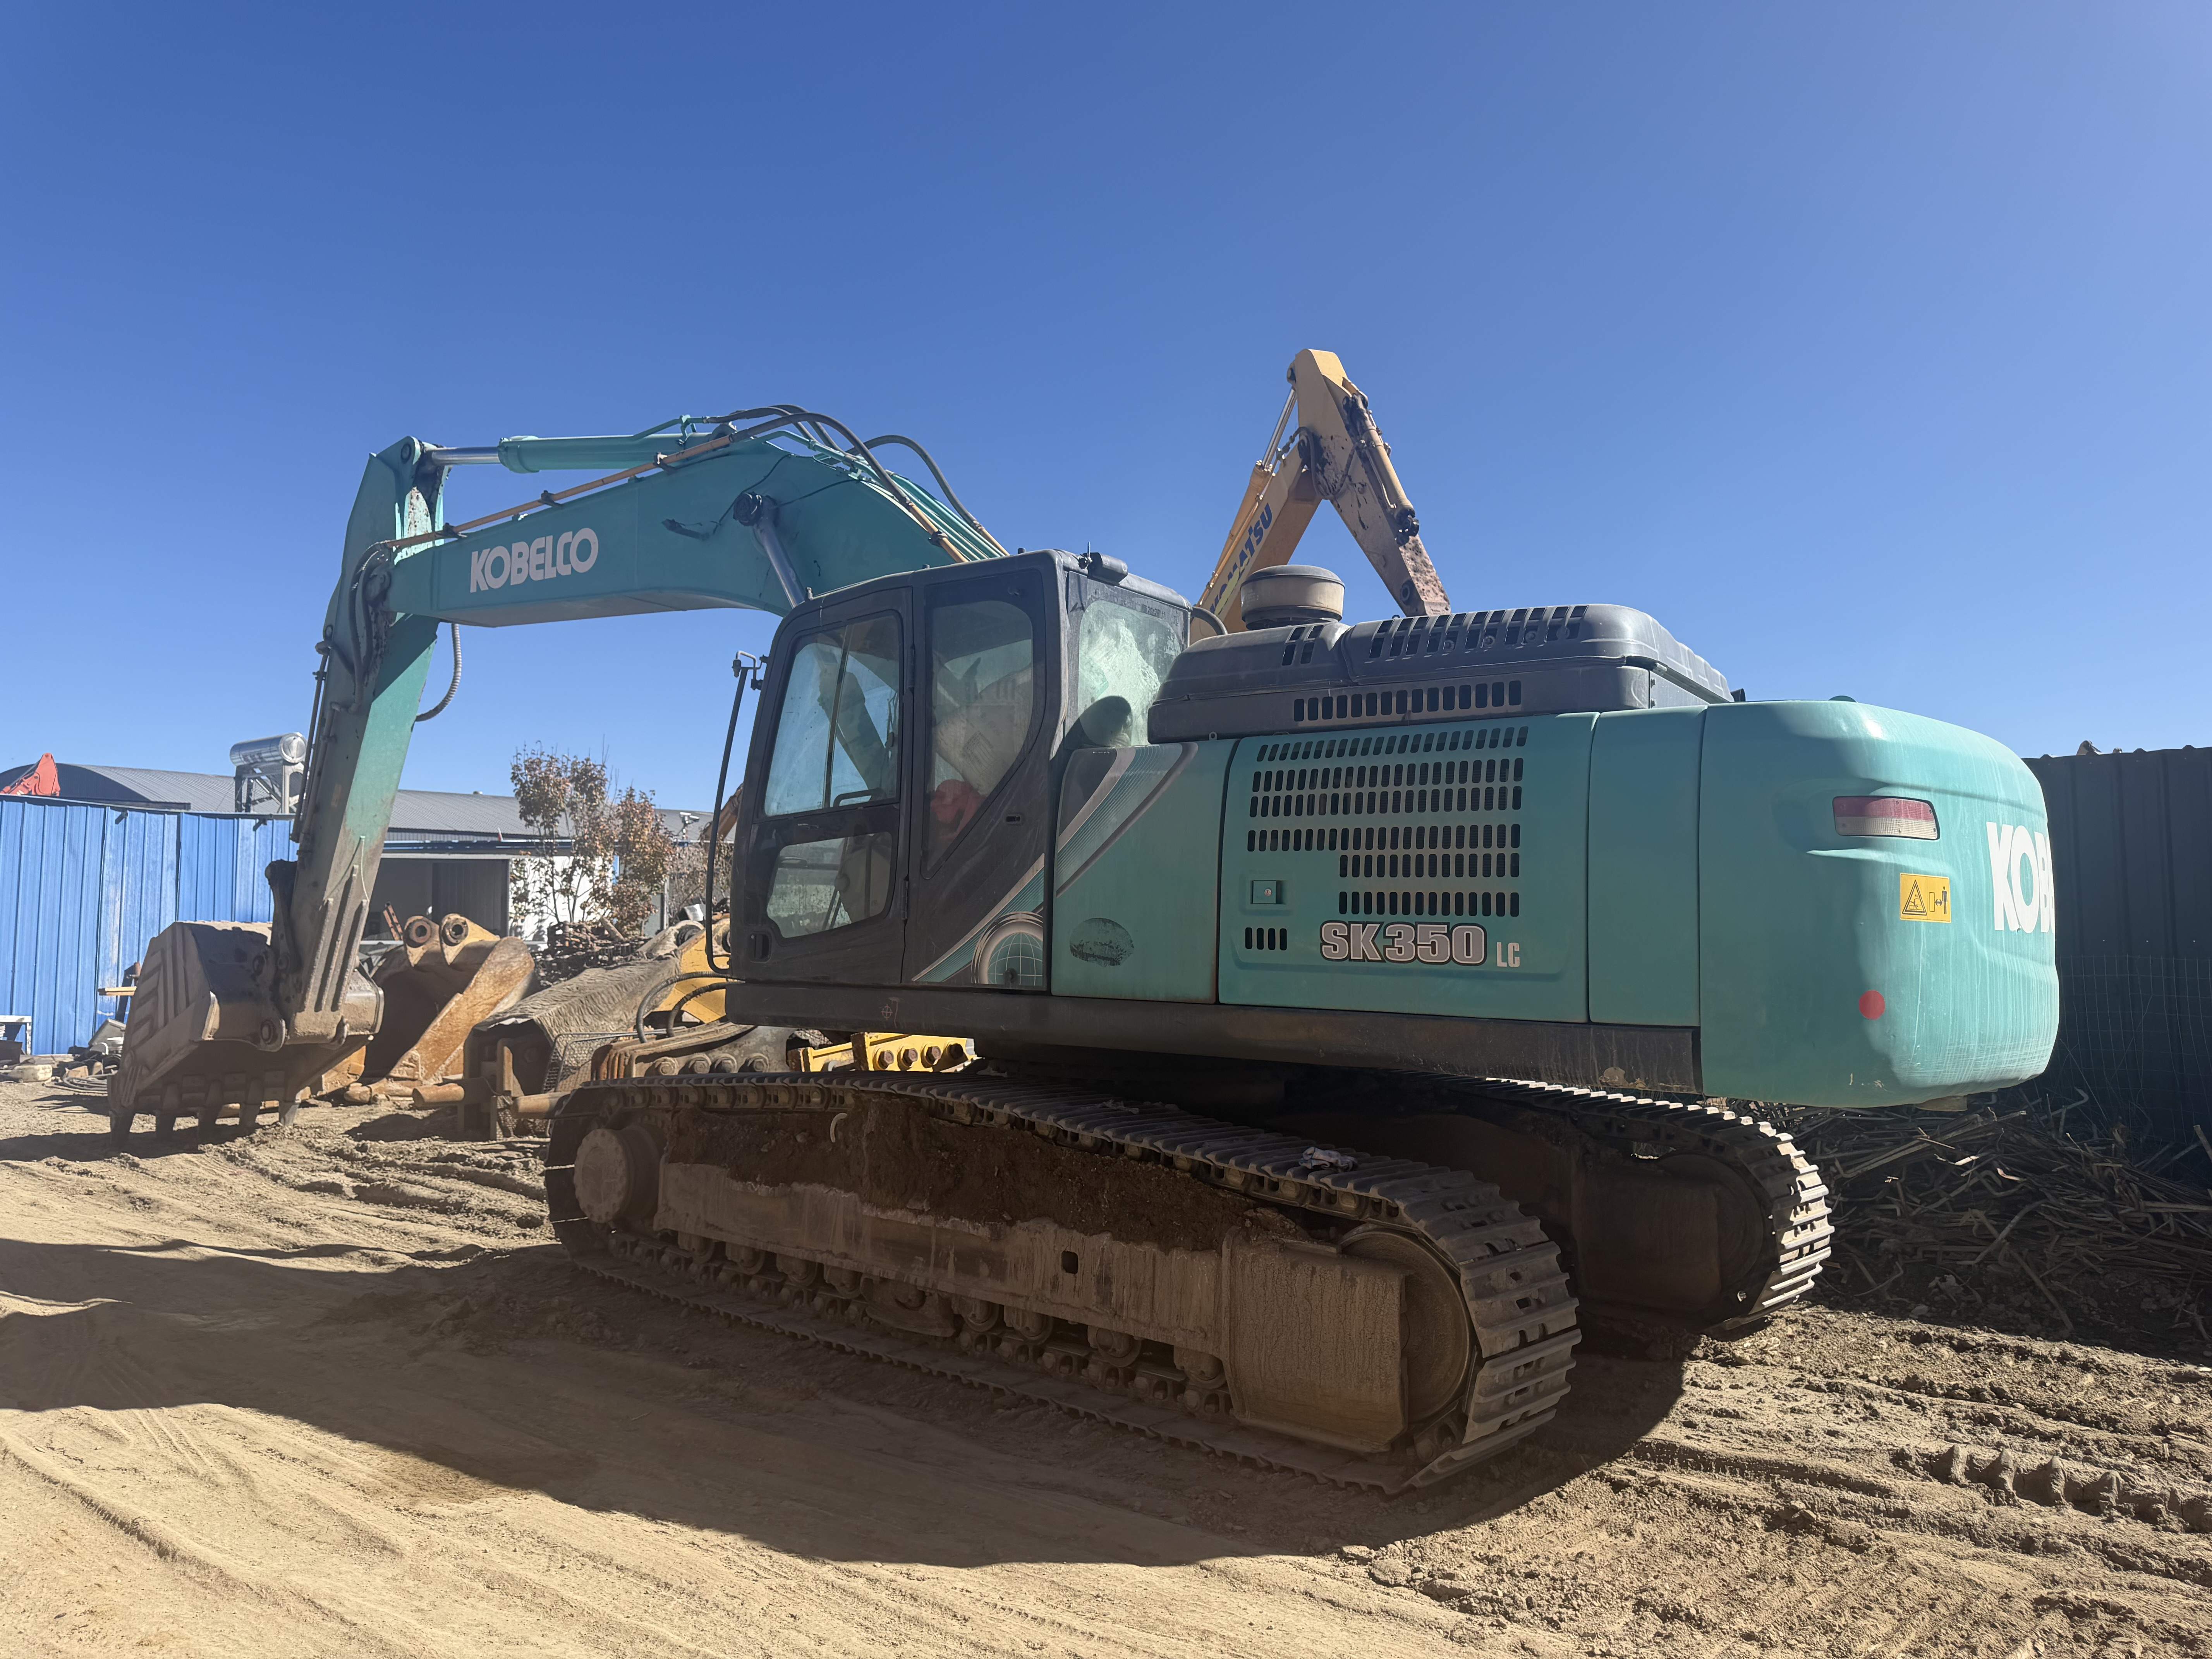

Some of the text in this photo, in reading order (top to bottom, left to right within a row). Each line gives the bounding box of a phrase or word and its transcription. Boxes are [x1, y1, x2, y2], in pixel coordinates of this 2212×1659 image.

[470, 528, 599, 593] KOBELCO
[1210, 503, 1272, 616] ATSU
[1320, 921, 1520, 967] SK350 LC
